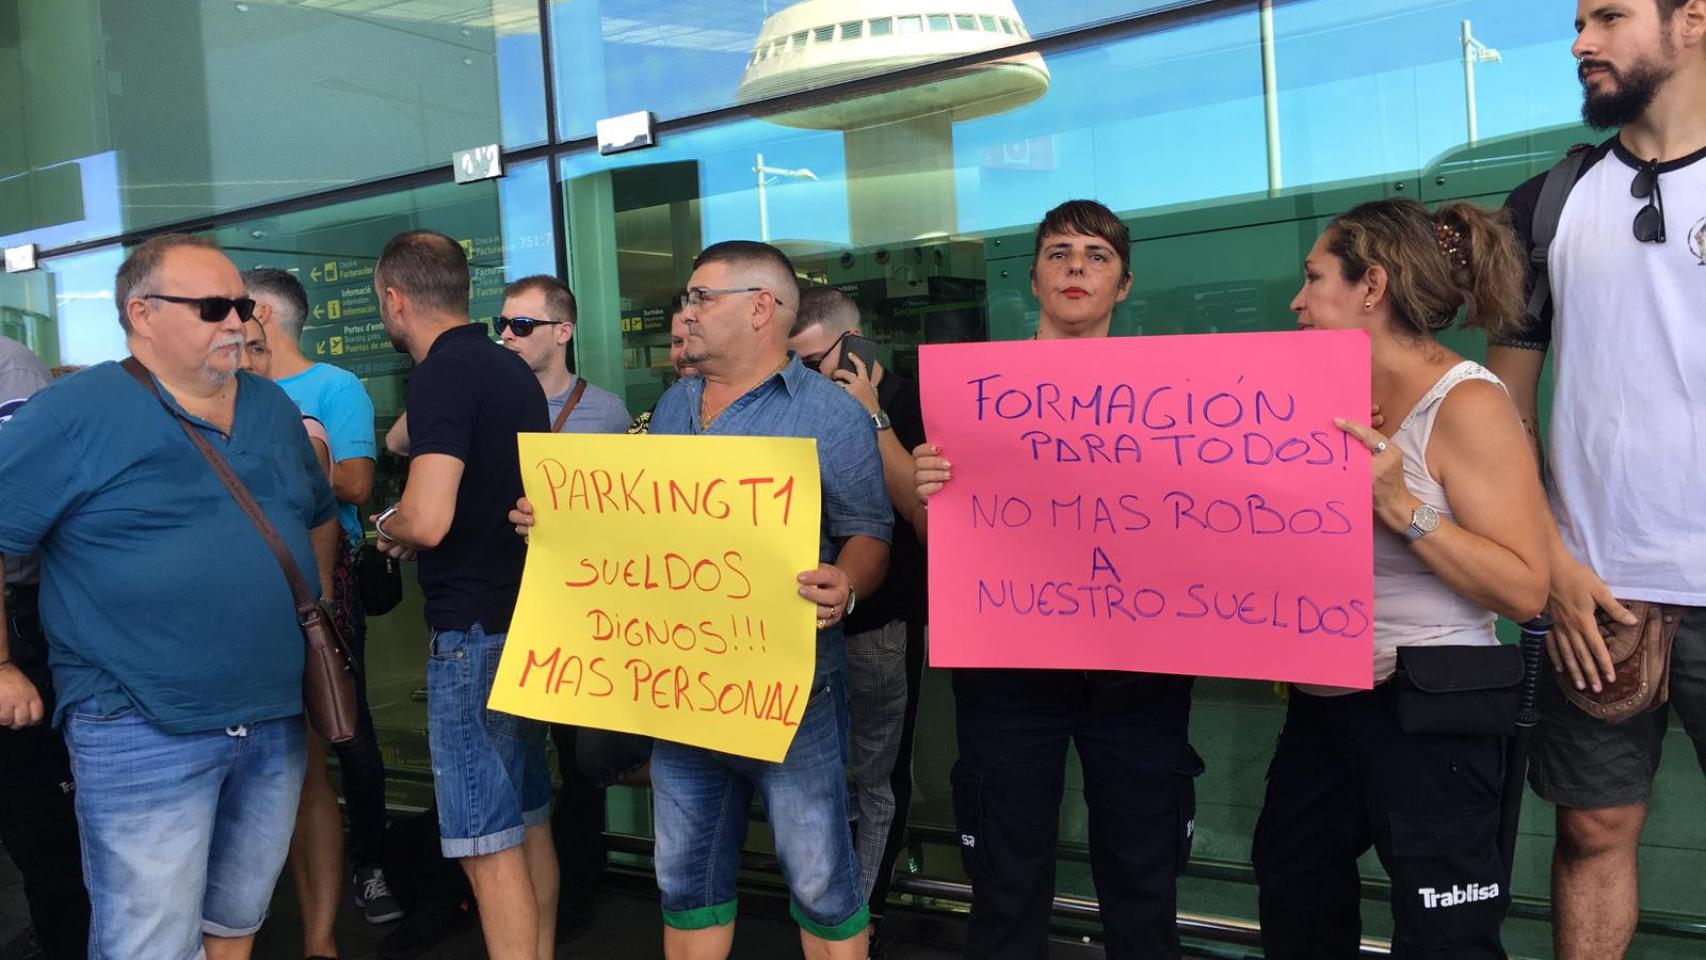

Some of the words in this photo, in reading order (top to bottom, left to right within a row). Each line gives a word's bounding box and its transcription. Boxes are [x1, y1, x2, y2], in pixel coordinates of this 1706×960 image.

[1020, 430, 1142, 464] PARA
[1151, 431, 1350, 471] TODOS!
[536, 457, 731, 520] PARKING
[738, 474, 795, 528] T1
[972, 494, 1032, 529] NO
[1051, 494, 1151, 535] MAS
[1162, 490, 1353, 535] ROBOS
[565, 550, 752, 600] SUELDOS
[1090, 545, 1122, 583] A
[978, 579, 1167, 622] NUESTRO
[1176, 583, 1370, 639] SUELDOS
[518, 645, 614, 697] MAS
[624, 657, 799, 727] PERSONAL
[1418, 882, 1500, 909] Trablisa
